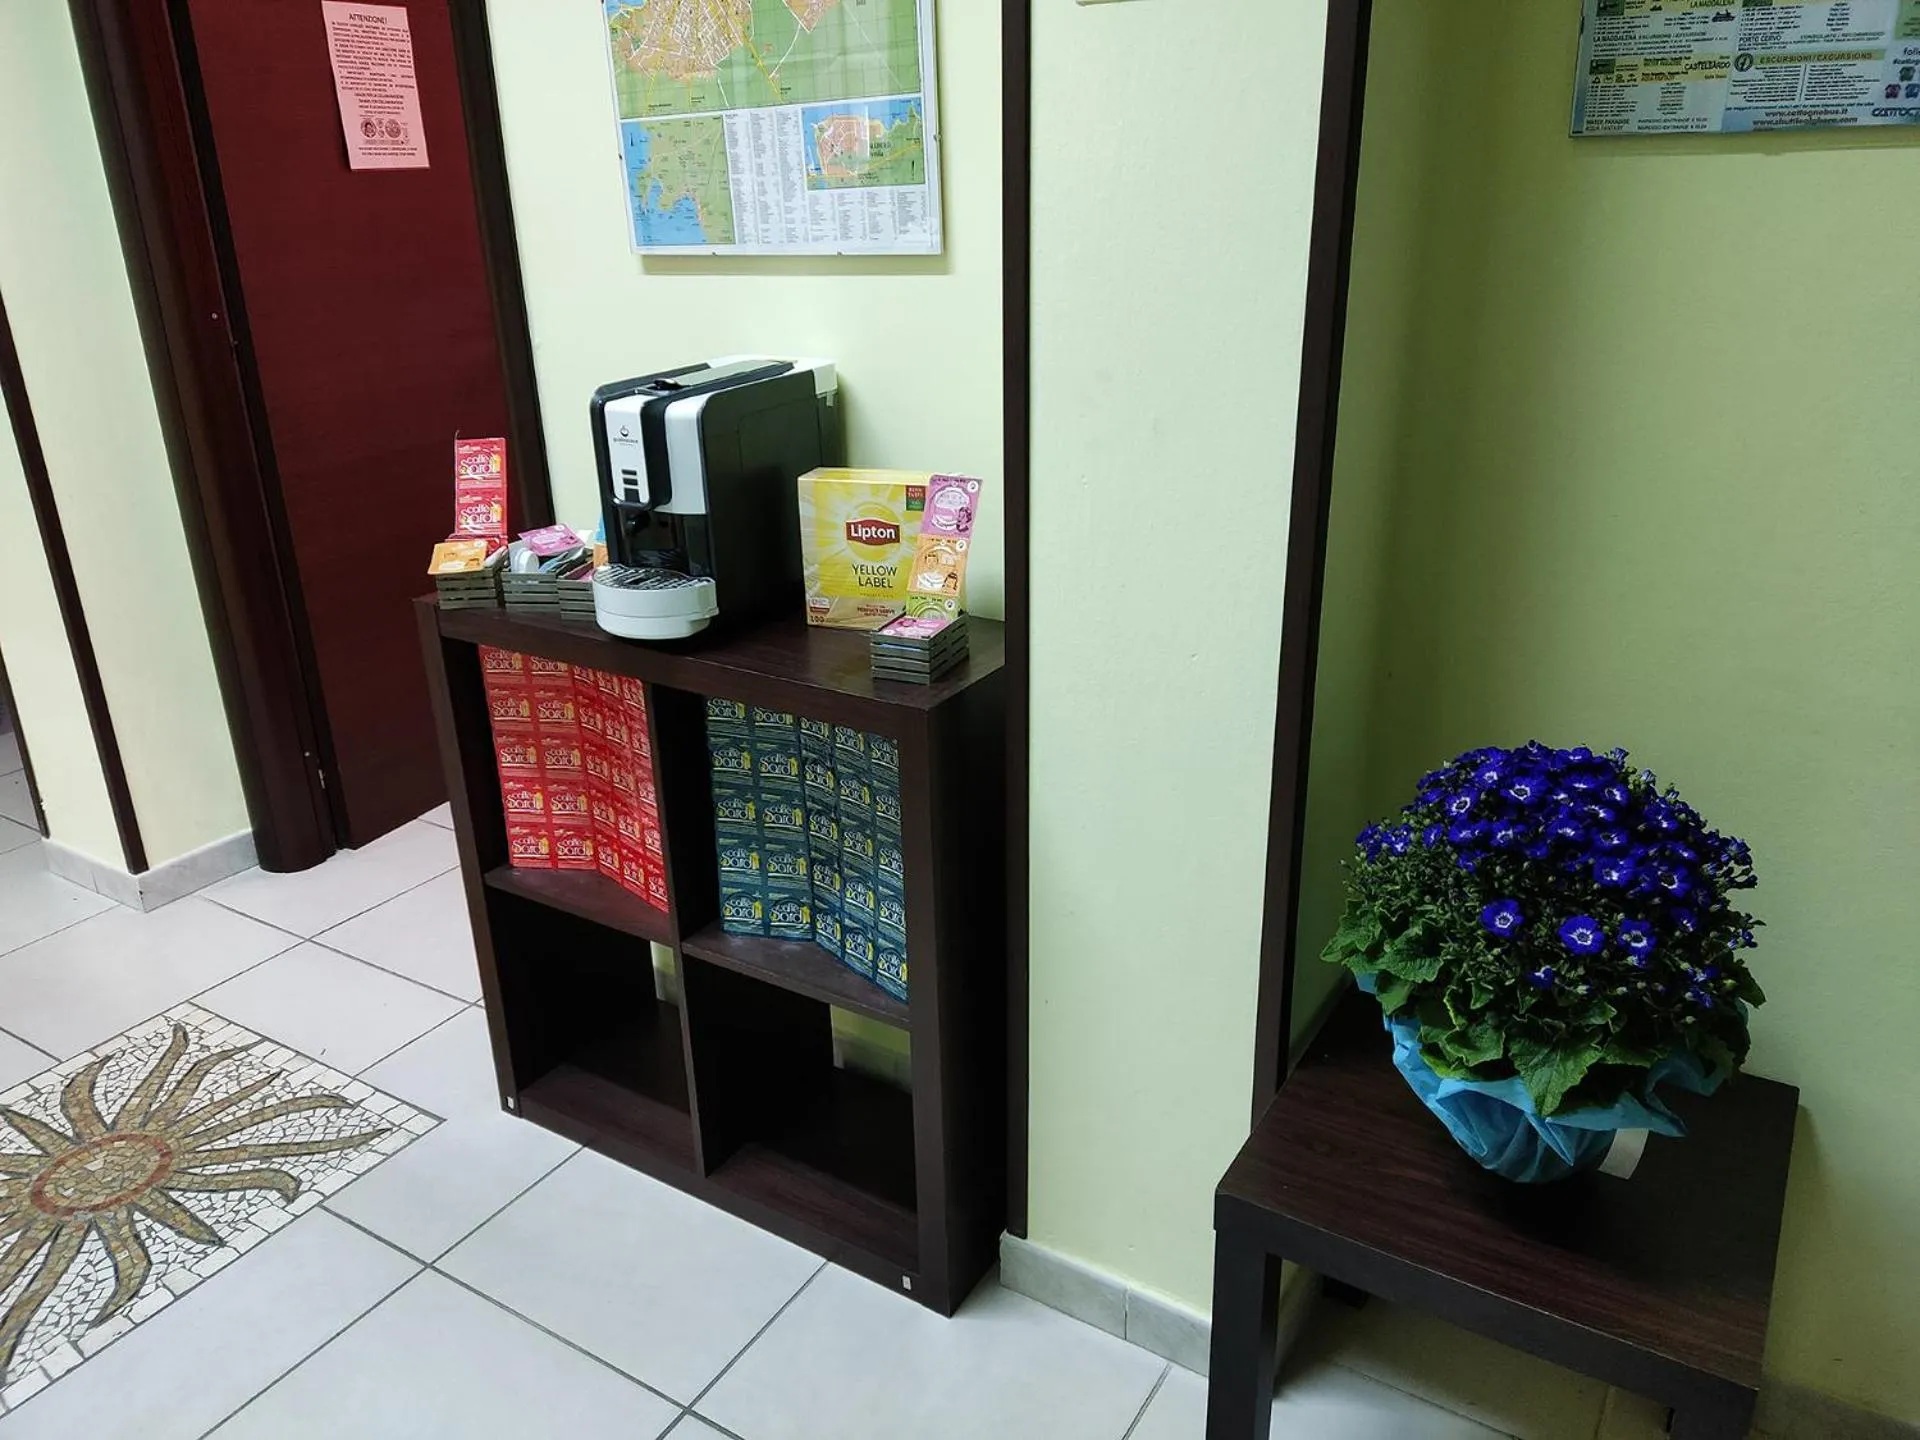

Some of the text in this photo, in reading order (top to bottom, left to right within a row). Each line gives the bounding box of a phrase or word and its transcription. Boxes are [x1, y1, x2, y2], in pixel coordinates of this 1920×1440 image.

[851, 524, 895, 540] Lipton
[852, 564, 897, 576] YELLOW
[859, 576, 893, 588] LABEL
